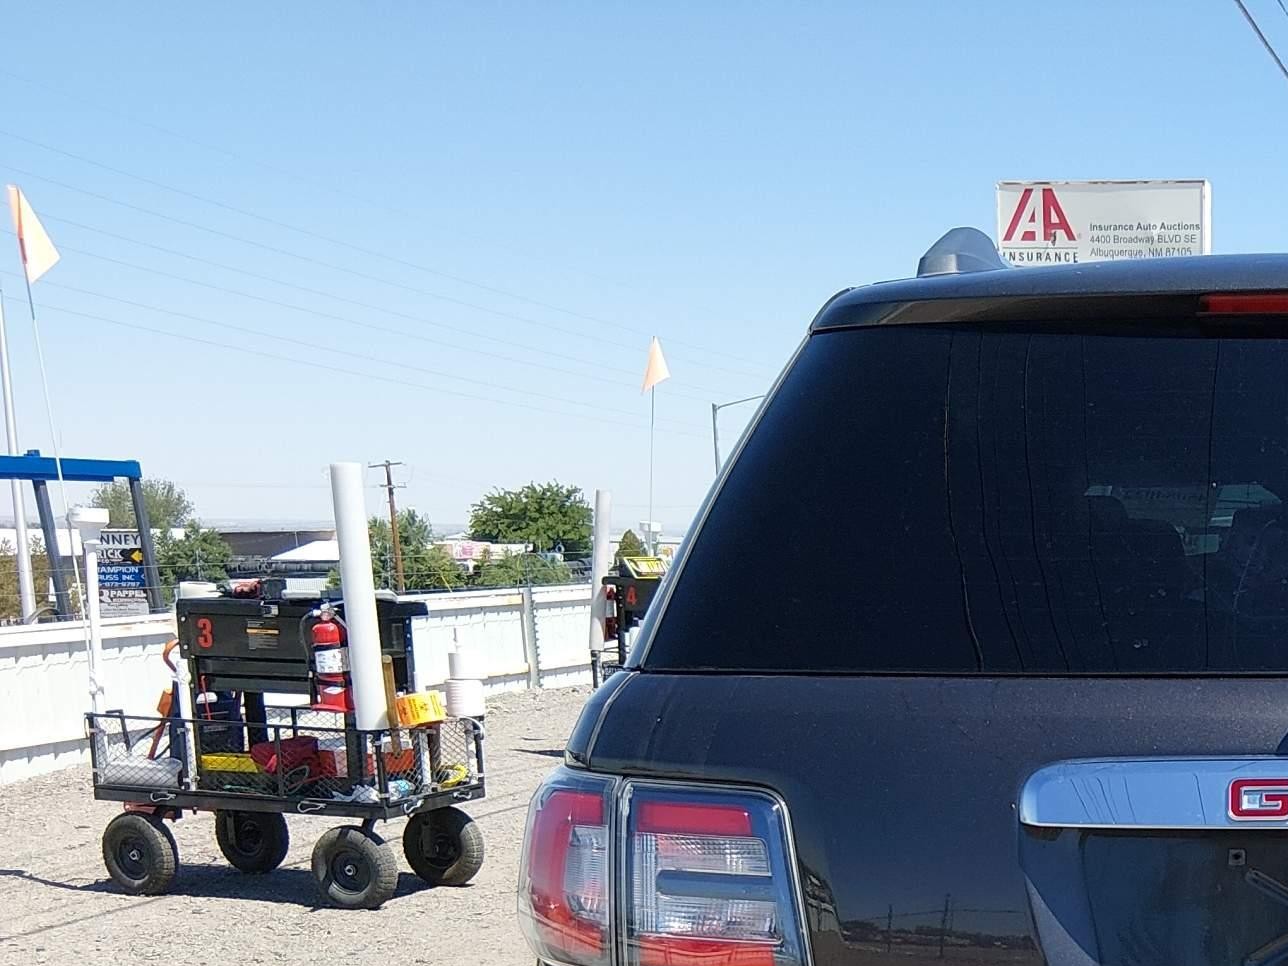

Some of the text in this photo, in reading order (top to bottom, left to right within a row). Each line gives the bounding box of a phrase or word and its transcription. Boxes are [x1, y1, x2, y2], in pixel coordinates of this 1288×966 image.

[1089, 222, 1201, 232] Insurance Auto Auctions
[1089, 234, 1197, 245] 4400 Broadway BLVD SE
[1089, 247, 1193, 260] Albuquerque, NM 87105
[197, 618, 213, 648] 3
